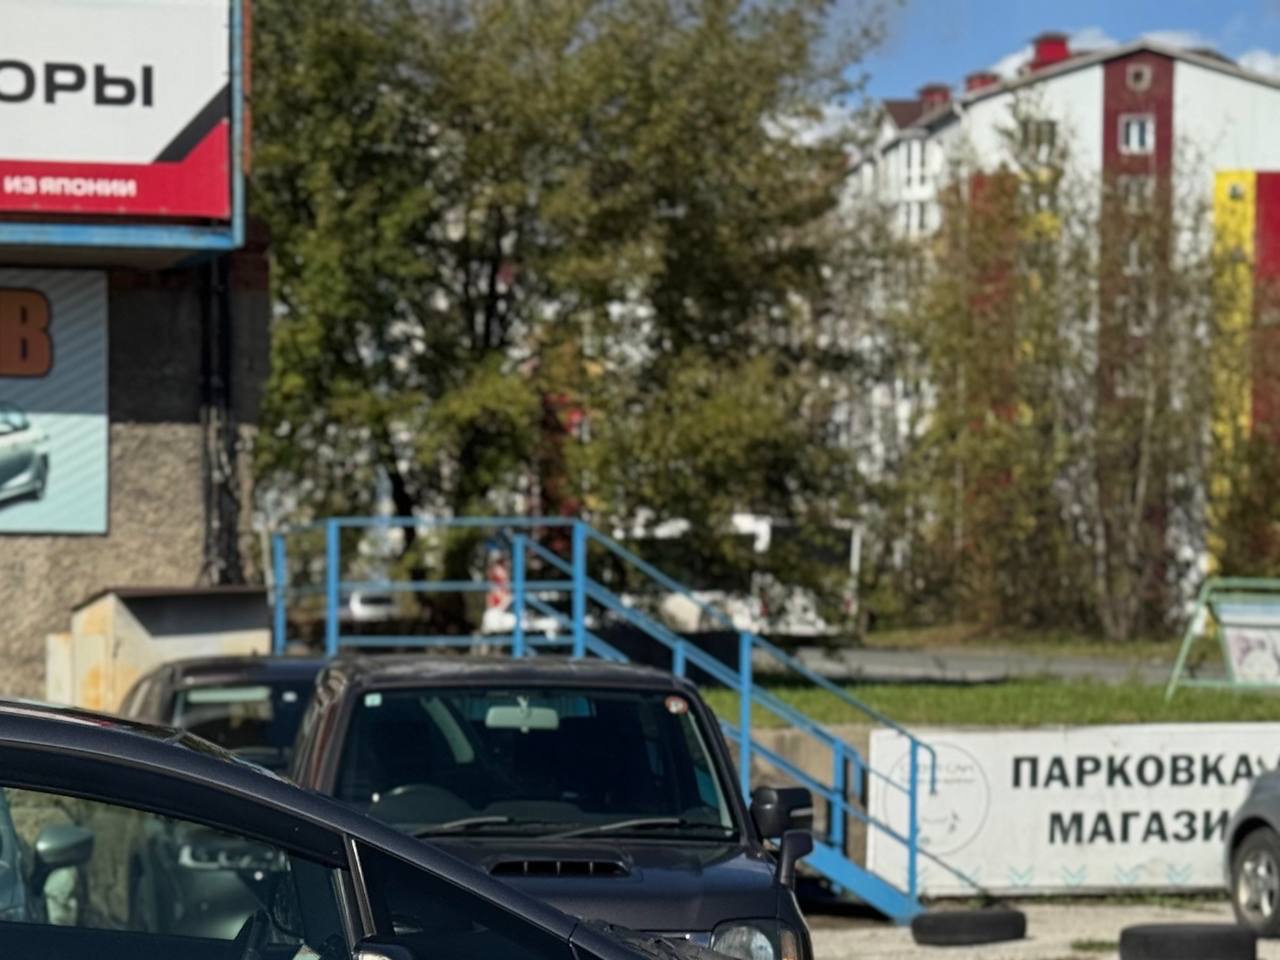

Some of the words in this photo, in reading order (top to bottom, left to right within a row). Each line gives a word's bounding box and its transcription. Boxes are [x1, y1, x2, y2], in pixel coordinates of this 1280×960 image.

[3, 176, 37, 195] ИЗ
[39, 177, 137, 198] ЯПОНИИ
[1012, 753, 1256, 788] ПАРКОВКА
